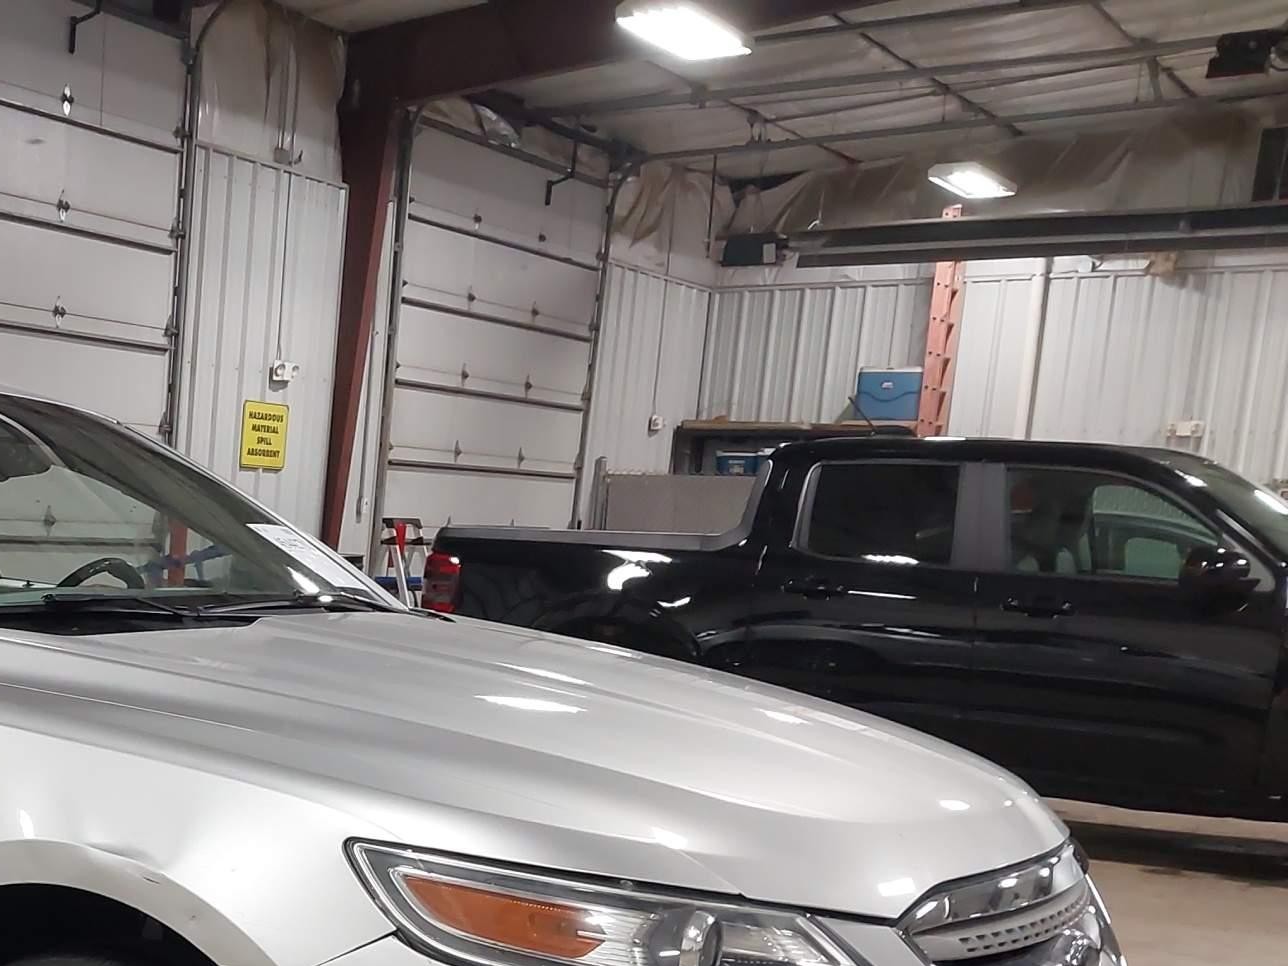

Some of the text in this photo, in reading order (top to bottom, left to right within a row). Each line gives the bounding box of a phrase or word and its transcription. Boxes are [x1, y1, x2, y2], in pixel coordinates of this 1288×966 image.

[248, 411, 284, 423] HAZARDOUS
[251, 423, 279, 434] MATERIAL
[256, 436, 272, 446] SPILL
[246, 447, 280, 458] ABSORBENT
